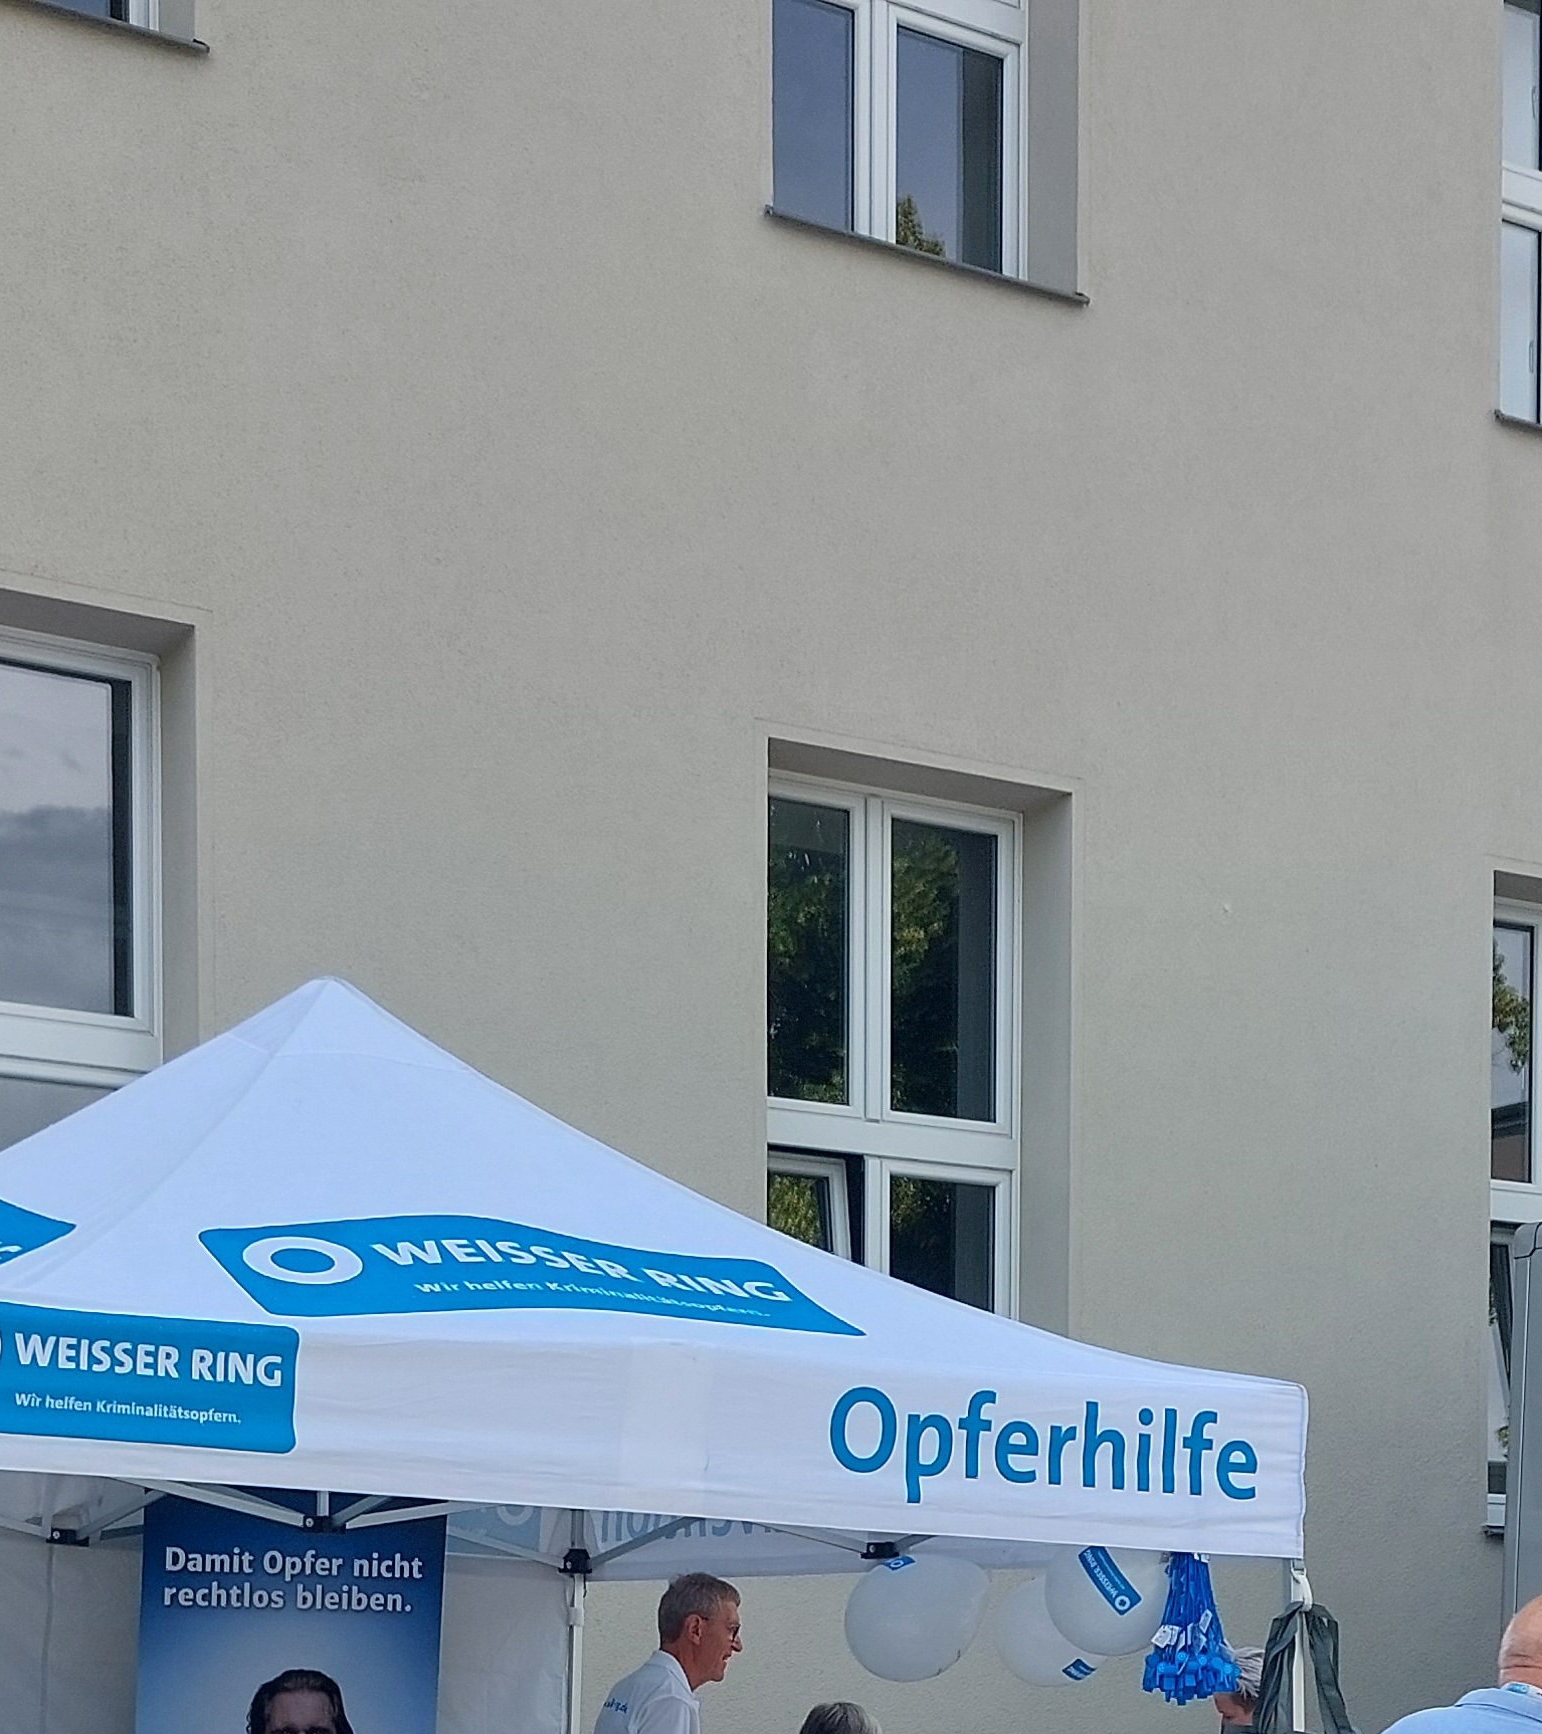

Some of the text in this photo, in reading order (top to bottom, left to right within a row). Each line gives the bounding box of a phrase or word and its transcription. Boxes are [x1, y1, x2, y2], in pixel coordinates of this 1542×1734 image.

[370, 1239, 793, 1302] WEISSER RING
[415, 1281, 460, 1294] Wir
[465, 1279, 545, 1293] helfen
[15, 1332, 283, 1387] WEISSER RING
[15, 1392, 242, 1427] Wir helfen Kriminalitätsopfern.
[828, 1384, 1259, 1504] Opferhilfe
[165, 1546, 423, 1582] Damit Opfer nicht
[163, 1580, 413, 1612] rechtlos bleiben.
